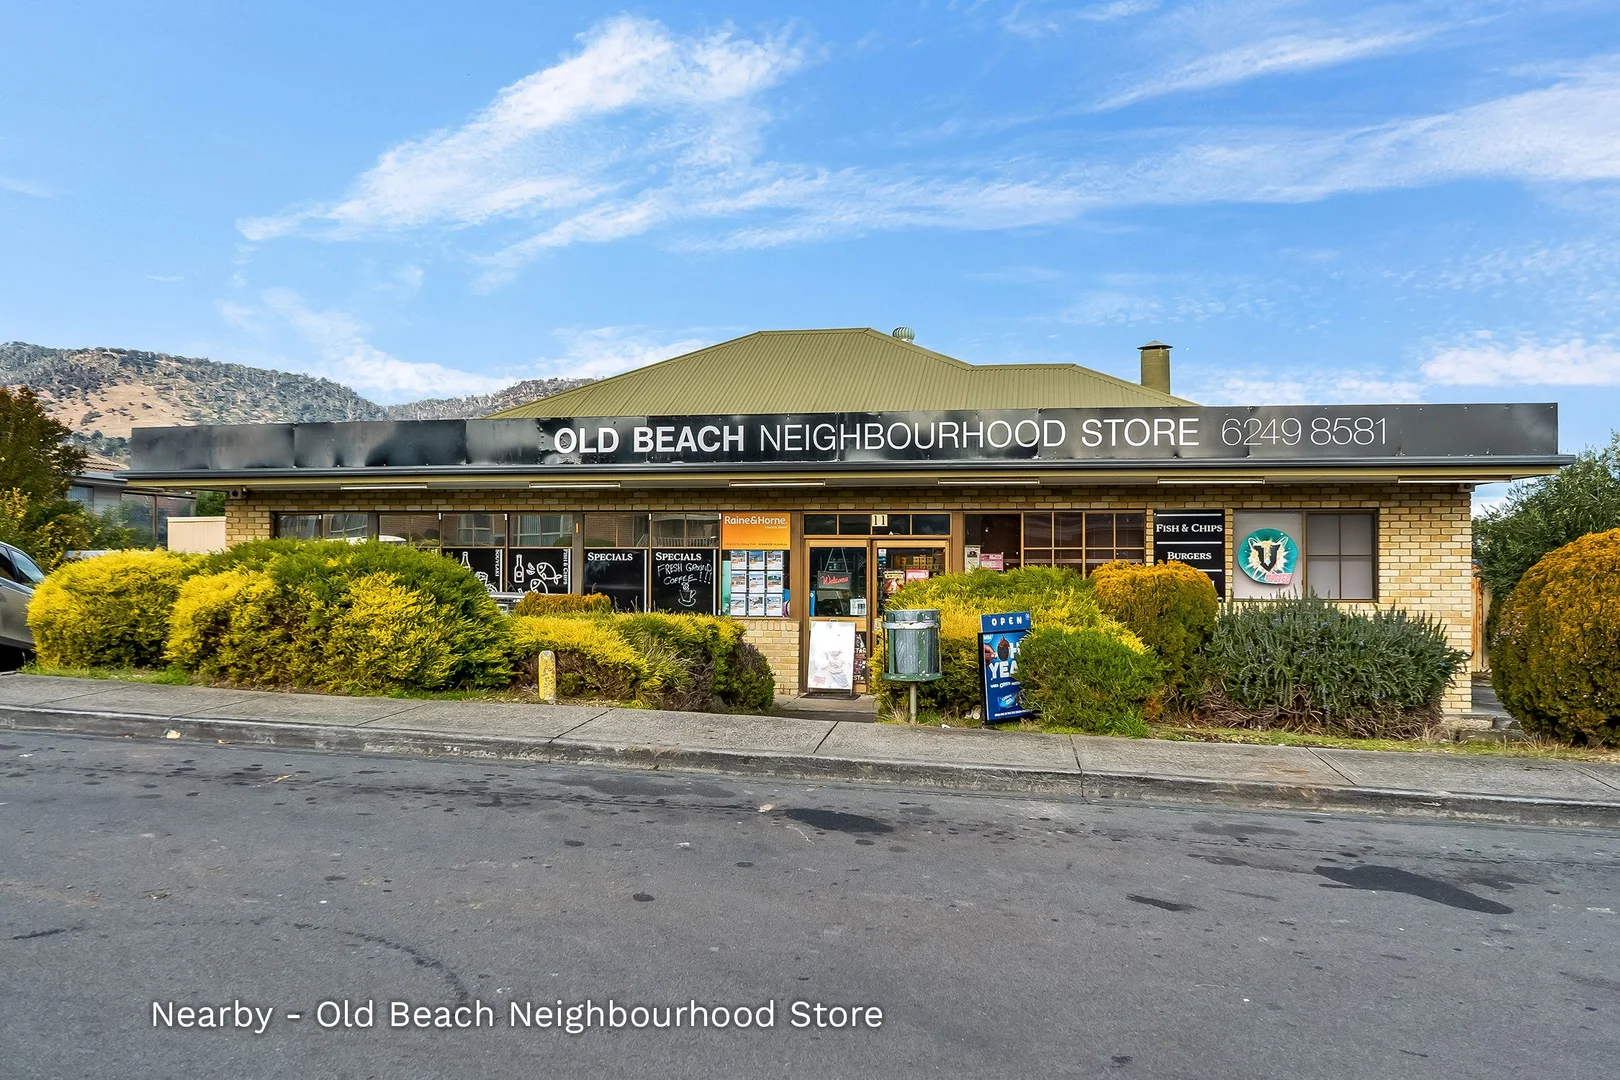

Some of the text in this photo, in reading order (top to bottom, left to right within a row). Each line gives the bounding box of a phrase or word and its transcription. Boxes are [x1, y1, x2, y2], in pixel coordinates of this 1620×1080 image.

[554, 417, 1387, 453] OLD BEACH NEIGHBOURHOOD STORE 6249 8581
[991, 616, 1023, 627] OPEN
